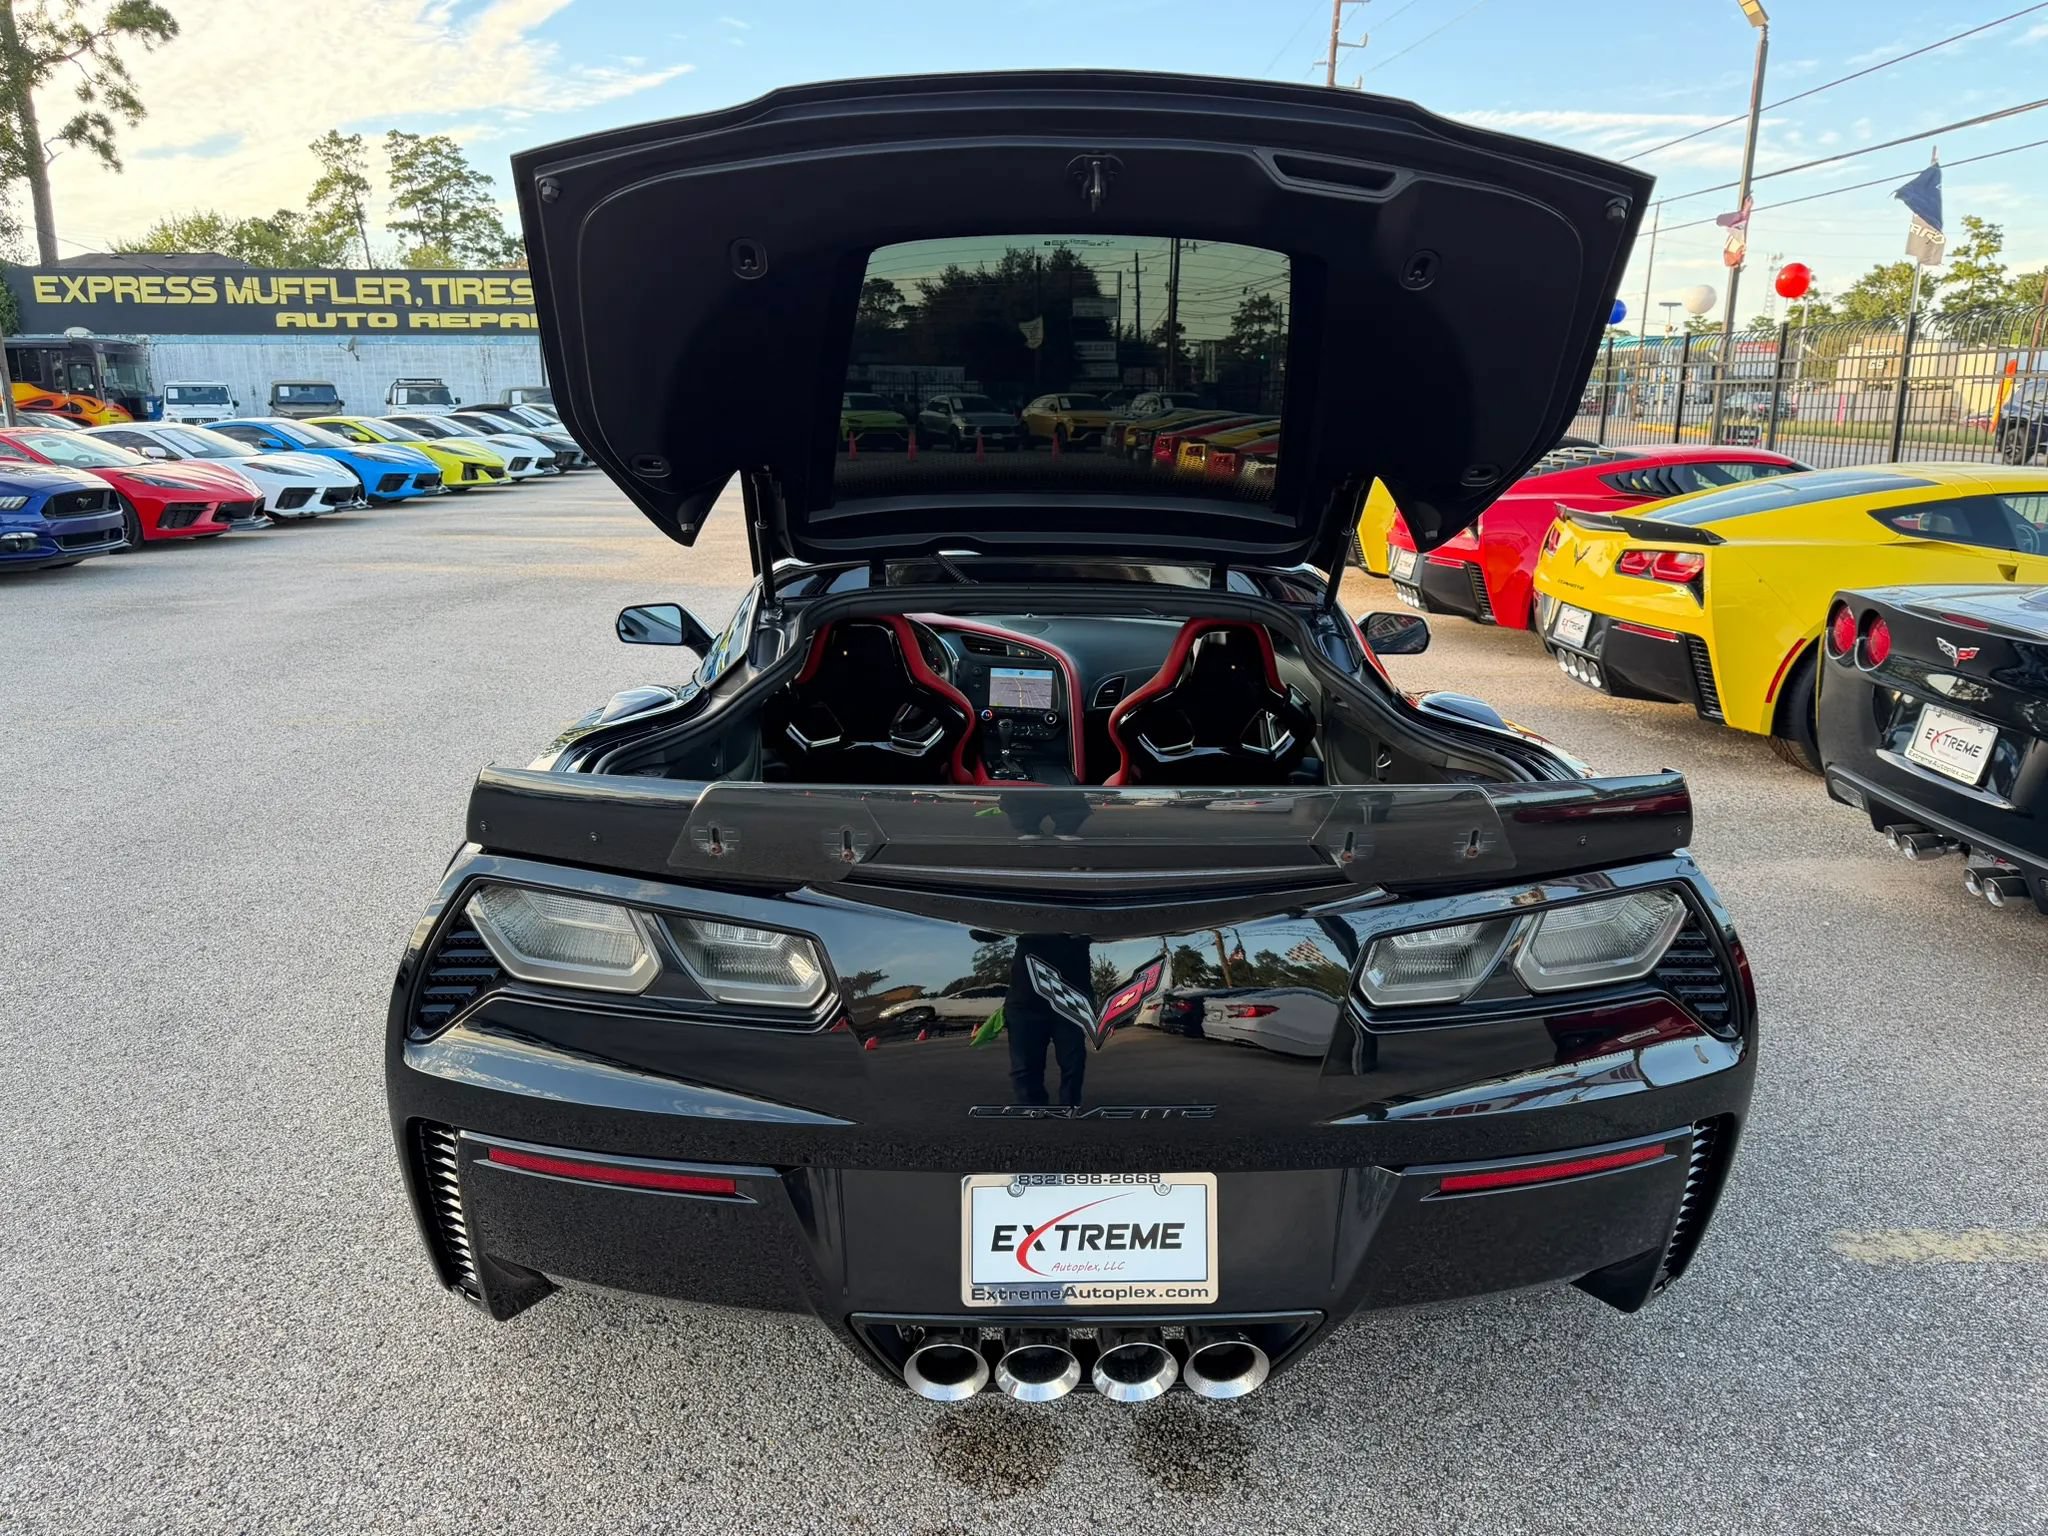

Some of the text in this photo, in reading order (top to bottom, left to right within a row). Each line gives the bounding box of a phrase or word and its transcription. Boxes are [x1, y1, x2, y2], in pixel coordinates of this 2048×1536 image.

[33, 275, 218, 304] EXPRESS
[276, 312, 398, 328] AUTO
[1924, 728, 1983, 758] EXTREME
[968, 1104, 1218, 1120] CORVETTE
[1017, 1173, 1161, 1185] 832-698-2668
[990, 1222, 1185, 1253] EXTREME
[1051, 1261, 1126, 1274] Autoplex, LLC
[971, 1285, 1210, 1302] ExtremeAutoplex.com
